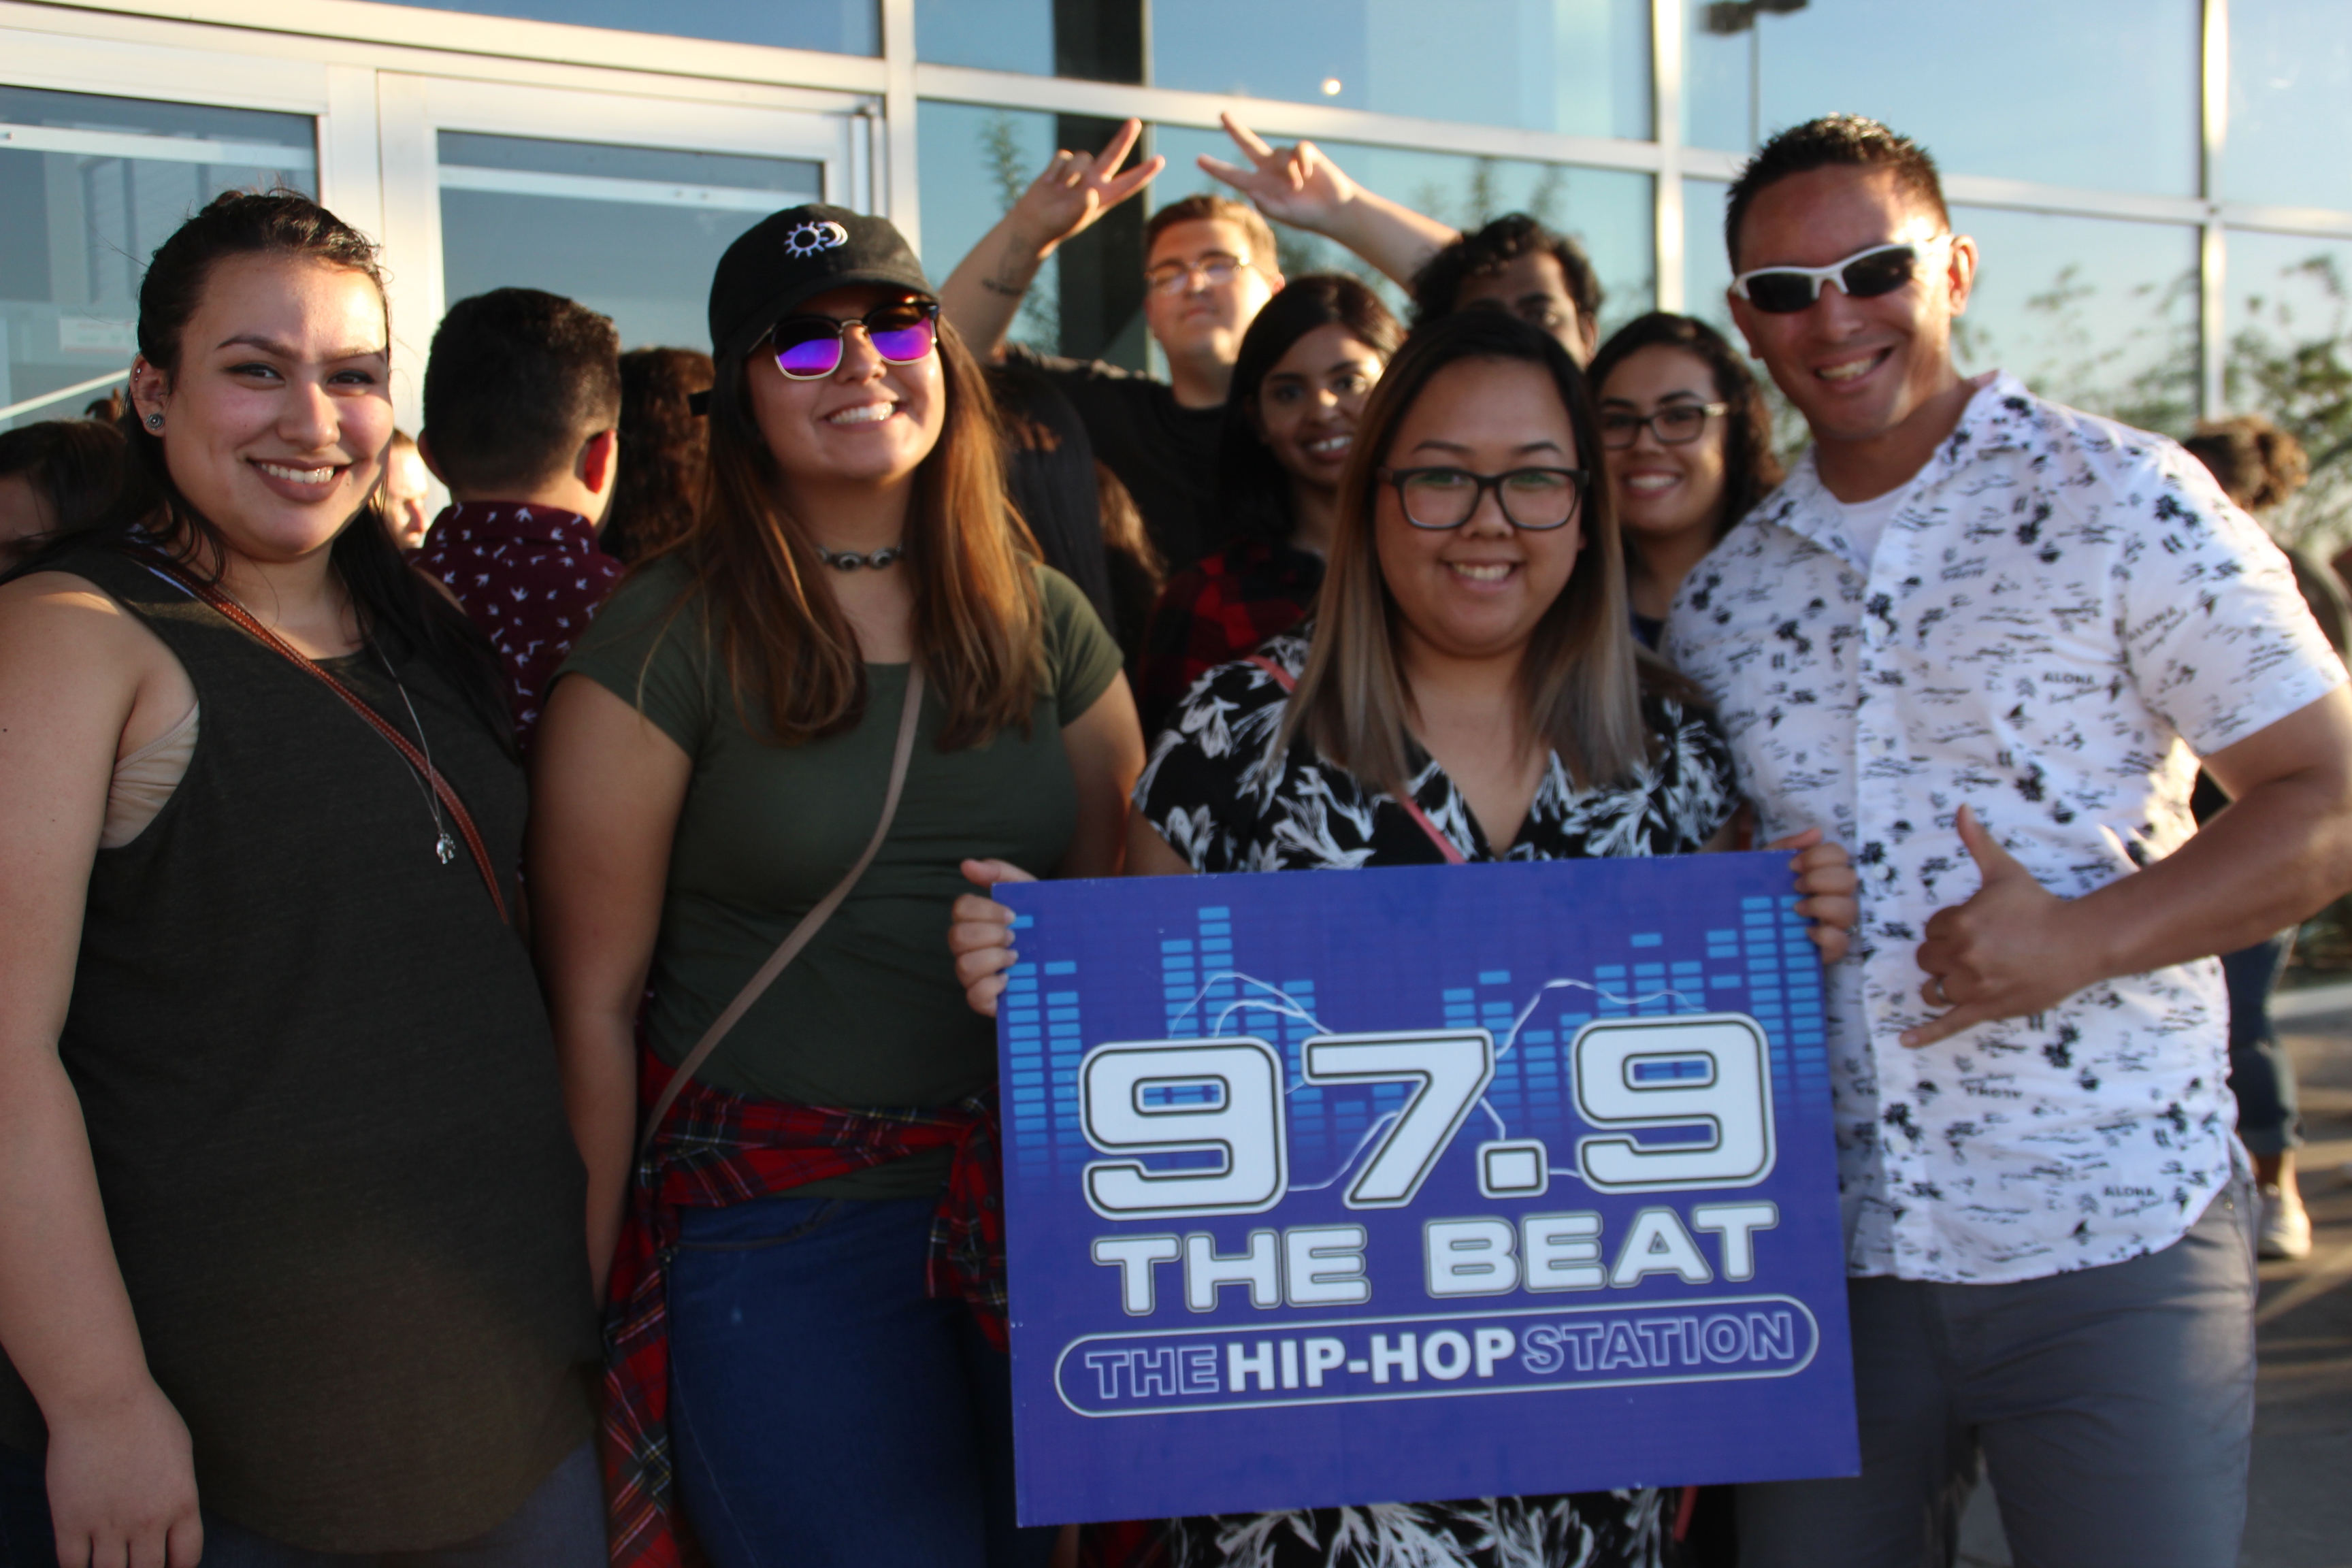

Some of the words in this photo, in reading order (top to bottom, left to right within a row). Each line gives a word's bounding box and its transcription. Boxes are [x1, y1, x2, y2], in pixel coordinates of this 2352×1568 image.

[2042, 672, 2095, 685] ALOHA
[1079, 1013, 1778, 1220] 97.9
[2103, 1185, 2156, 1197] ALOHA
[1092, 1223, 1372, 1318] THE
[1423, 1200, 1780, 1299] BEAT
[1085, 1343, 1220, 1401] THE
[1229, 1327, 1516, 1392] HIP-HOP
[1522, 1313, 1795, 1377] STATION
